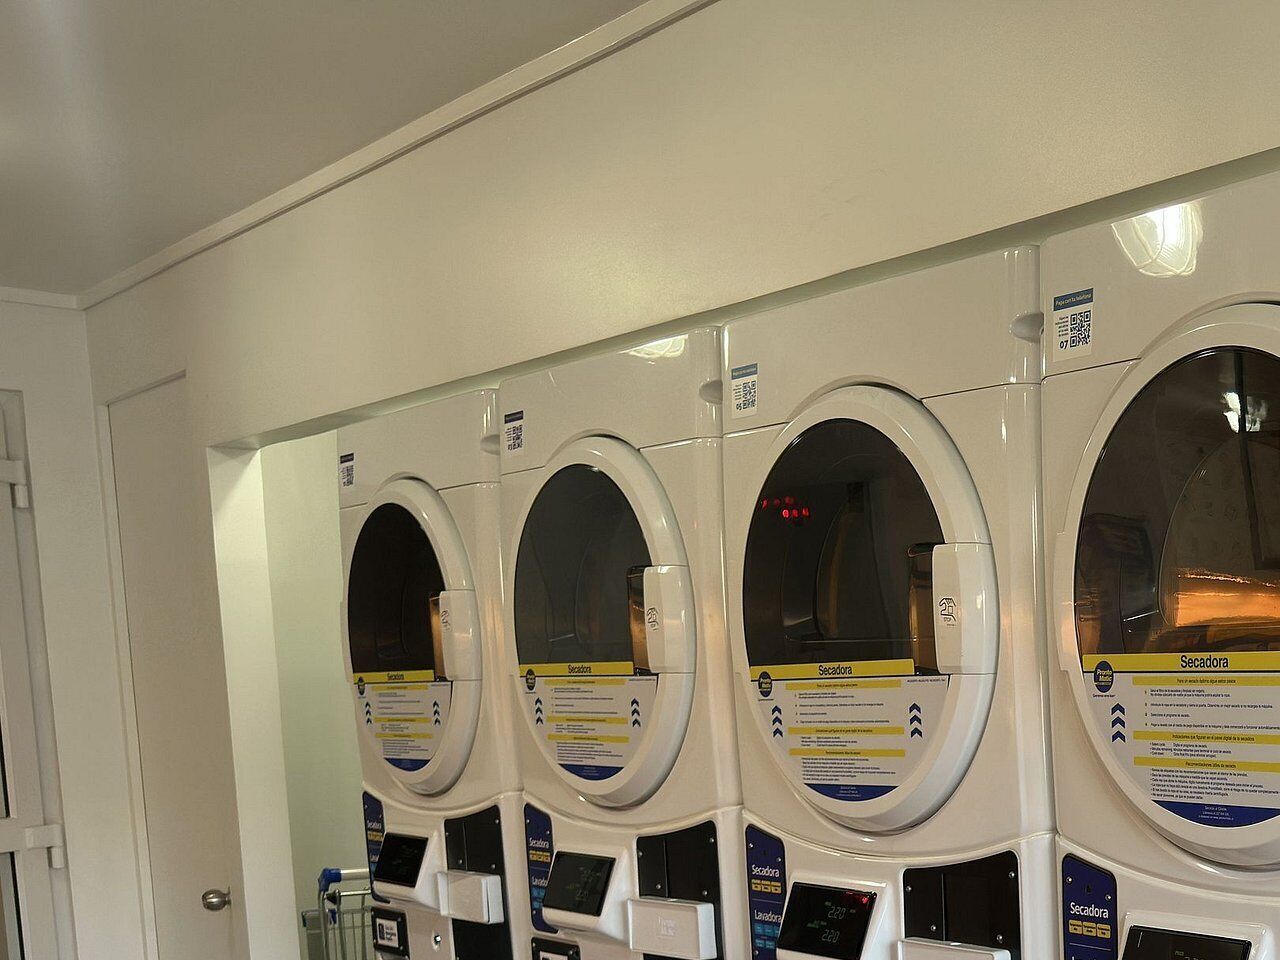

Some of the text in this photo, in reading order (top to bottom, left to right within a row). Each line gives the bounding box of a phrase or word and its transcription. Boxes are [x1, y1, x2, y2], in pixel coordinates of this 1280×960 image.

[1060, 340, 1068, 350] 07
[1180, 654, 1229, 669] Secadora
[568, 664, 592, 674] Secadora
[818, 664, 852, 676] Secadora
[752, 864, 780, 878] Secadora
[1070, 902, 1108, 918] Secadora
